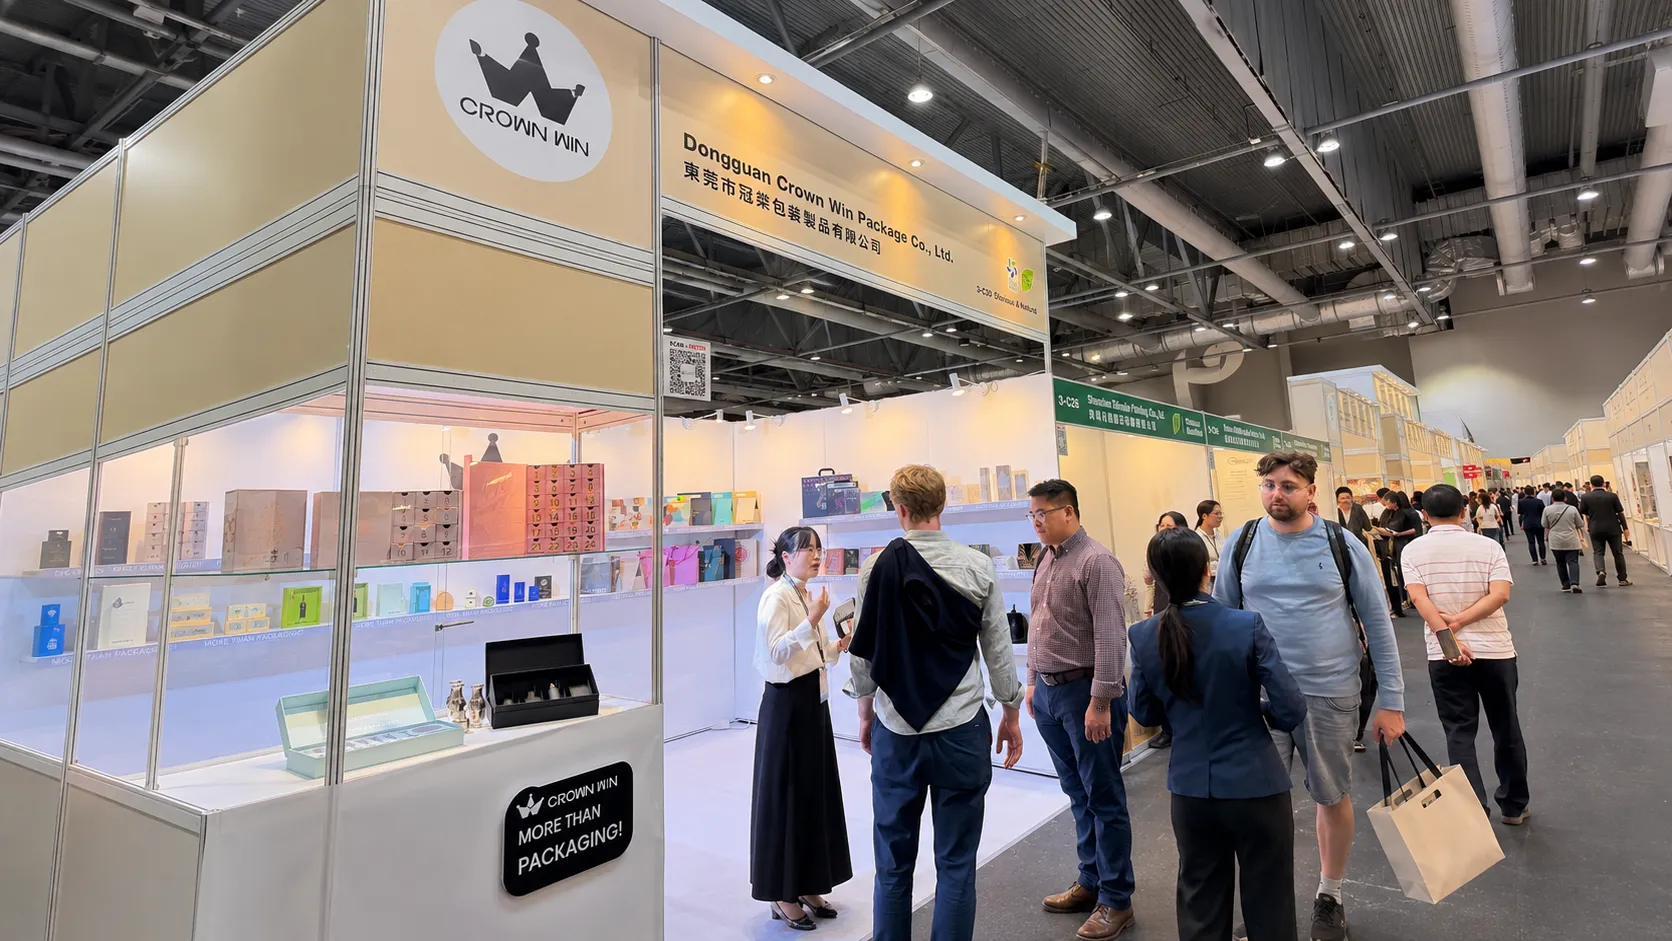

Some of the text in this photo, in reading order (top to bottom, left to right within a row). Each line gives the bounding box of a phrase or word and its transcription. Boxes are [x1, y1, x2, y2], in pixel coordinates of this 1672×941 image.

[460, 97, 589, 157] CROWN WIN
[683, 132, 954, 263] Dongguan Crown Win Package Co., Ltd.
[547, 775, 618, 808] CROWN WIN
[518, 804, 601, 846] MORE THAN
[518, 821, 623, 875] PACKAGING!
